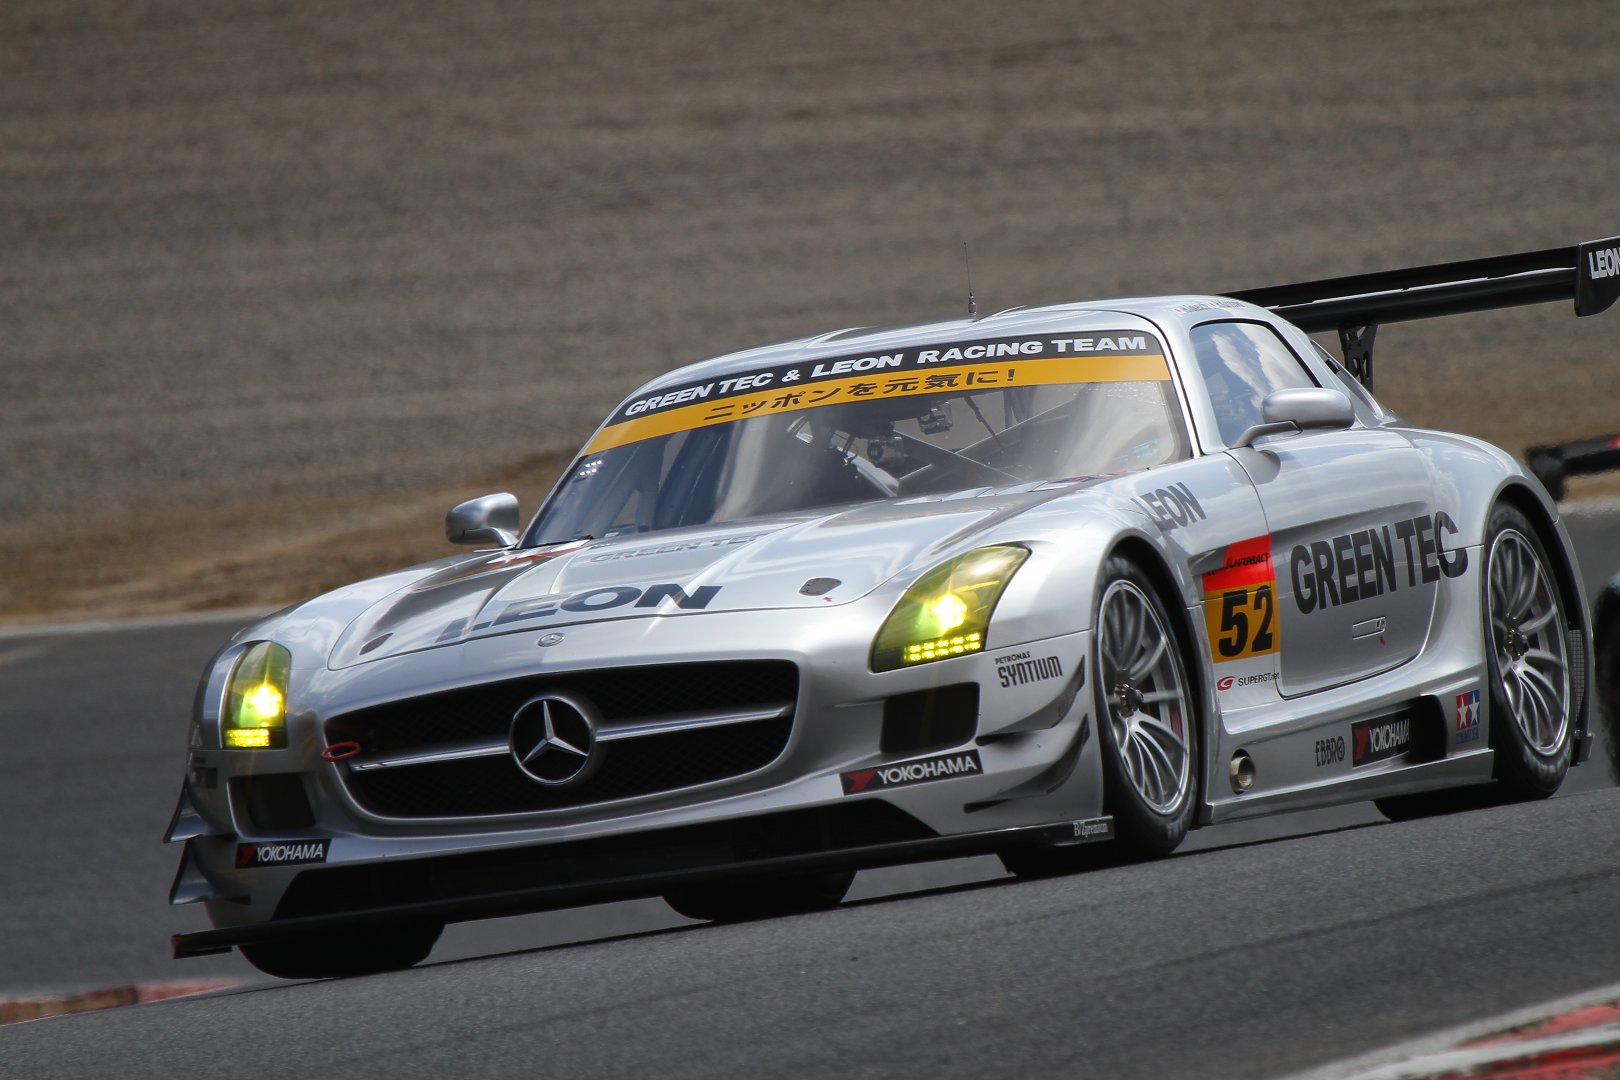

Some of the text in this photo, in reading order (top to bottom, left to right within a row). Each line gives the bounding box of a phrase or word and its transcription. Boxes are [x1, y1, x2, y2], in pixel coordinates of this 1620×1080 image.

[624, 335, 1148, 417] GREEN TEC & LEON RACING TEAM
[1131, 481, 1207, 532] LEON
[1290, 511, 1469, 615] GREEN TEC
[434, 583, 723, 644] LEON
[1218, 584, 1275, 658] 52
[994, 650, 1031, 665] PETRONAS
[997, 656, 1063, 688] SYNTIUM
[1369, 719, 1410, 752] YOKOHAMA
[877, 755, 978, 785] YOKOHAMA
[256, 843, 324, 863] YOKOHAMA
